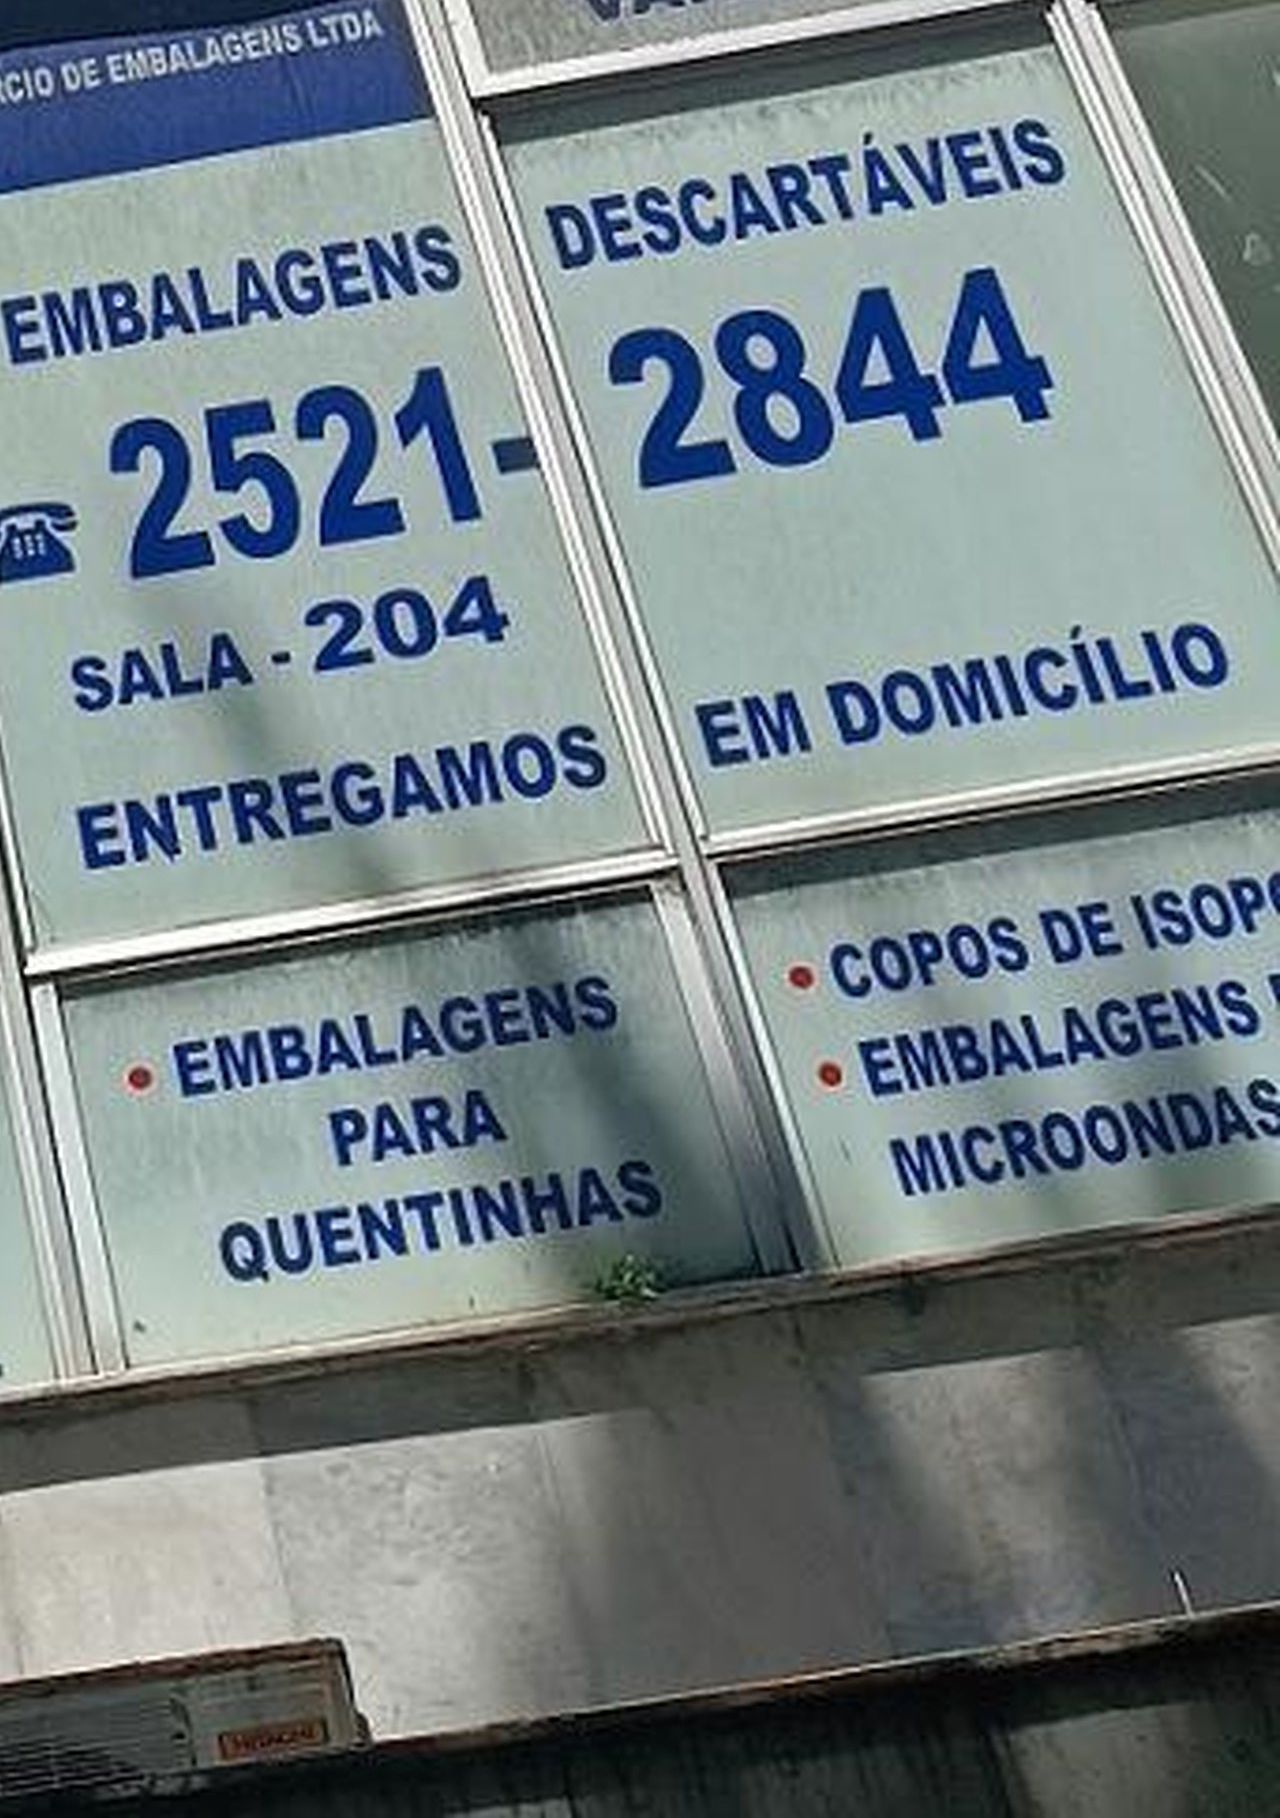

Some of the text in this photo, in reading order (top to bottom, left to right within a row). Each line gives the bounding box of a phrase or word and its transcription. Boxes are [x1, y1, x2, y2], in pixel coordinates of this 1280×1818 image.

[61, 56, 101, 92] DE
[108, 21, 305, 85] EMBALAGENS
[307, 8, 383, 49] LTDA
[544, 118, 1067, 269] DESCARTÁVEIS
[0, 225, 461, 365] EMBALAGENS
[607, 267, 1055, 489] 2844
[70, 633, 254, 712] SALA
[304, 576, 509, 672] 204
[695, 622, 1229, 768] EM DOMICÍLIO
[76, 725, 607, 870] ENTREGAMOS
[829, 916, 1030, 998] COPOS
[1039, 901, 1123, 964] DE
[171, 975, 618, 1097] EMBALAGENS
[858, 980, 1261, 1097] EMBALAGENS
[329, 1088, 507, 1166] PARA
[889, 1077, 1280, 1197] MICROONDAS
[218, 1159, 663, 1283] QUENTINHAS
